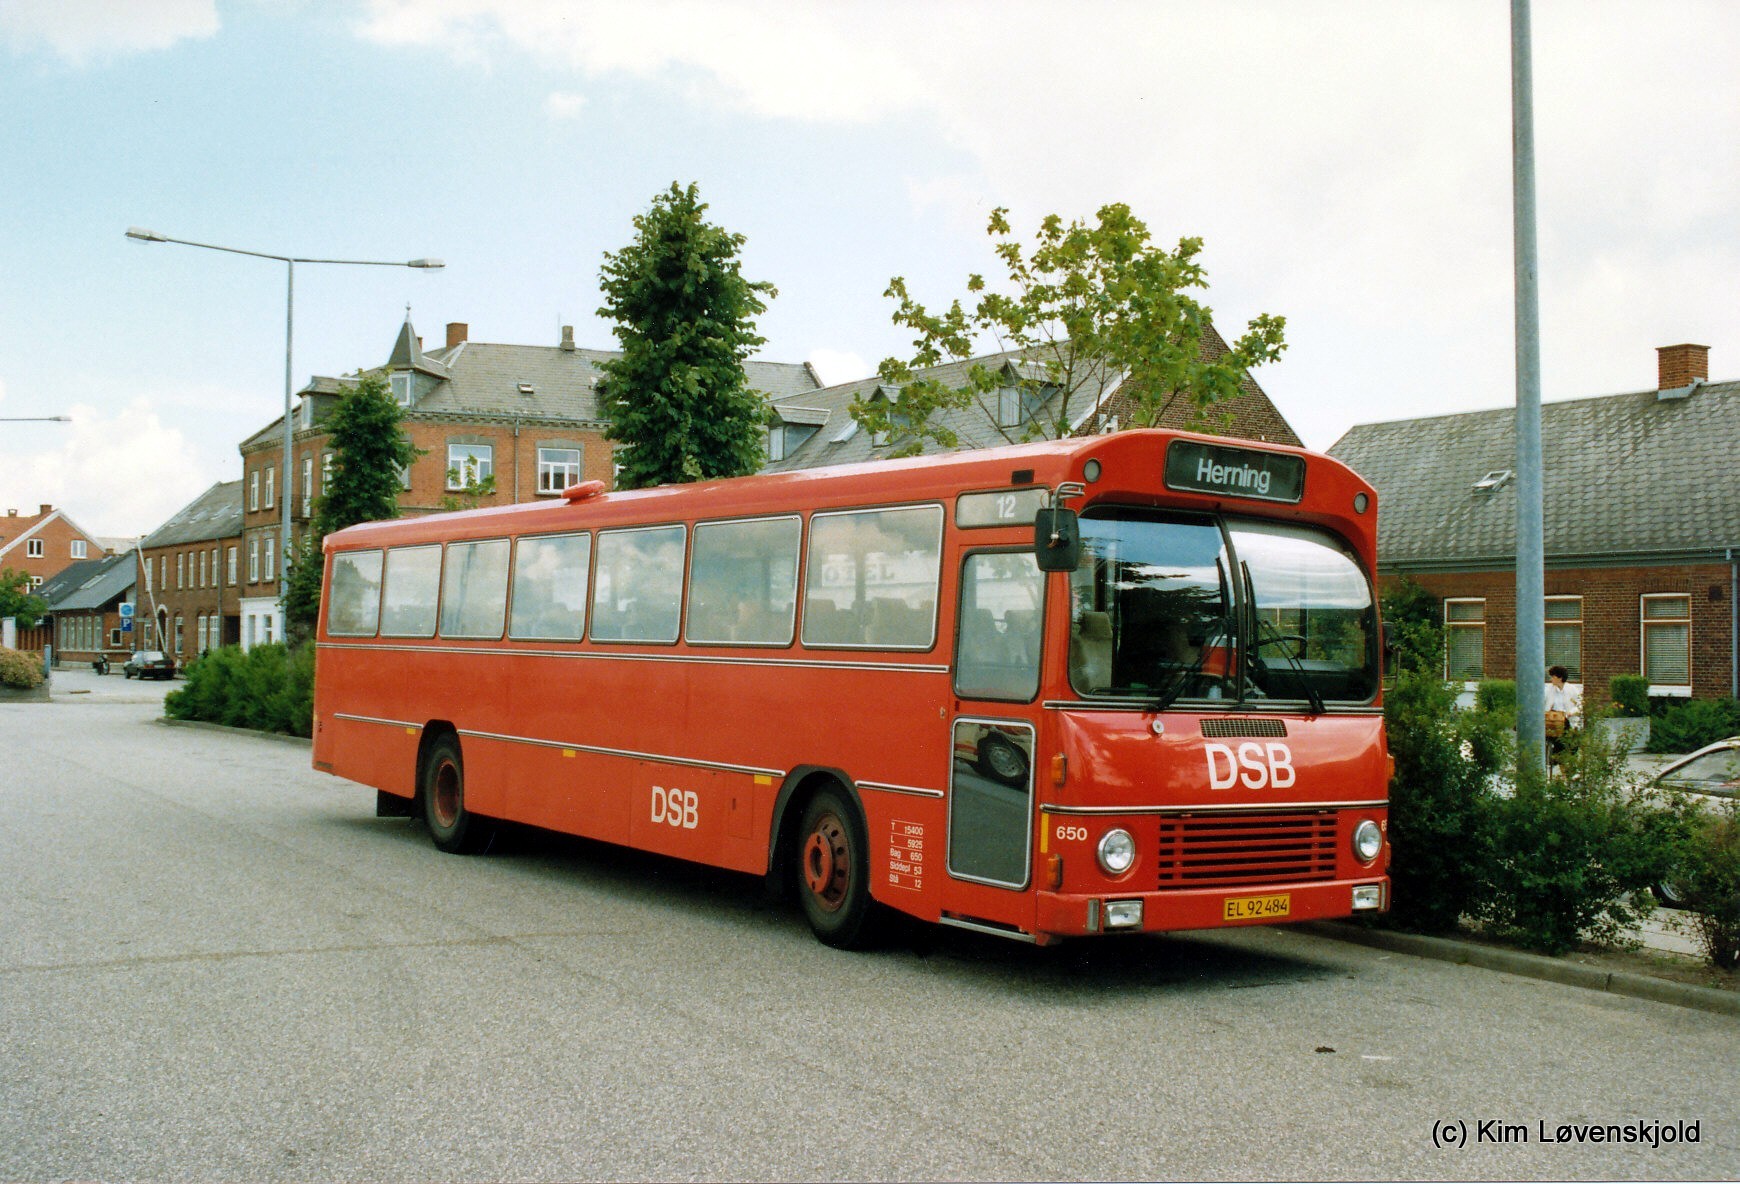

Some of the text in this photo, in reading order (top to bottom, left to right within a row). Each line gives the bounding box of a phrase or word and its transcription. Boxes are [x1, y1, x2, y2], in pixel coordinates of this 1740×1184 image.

[1196, 457, 1271, 494] Herning
[996, 494, 1016, 518] 12
[1204, 742, 1296, 790] DSB
[651, 785, 699, 830] DSB
[891, 822, 924, 836] T 15400
[1056, 825, 1088, 841] 650
[890, 835, 923, 849] L 5925
[889, 847, 923, 862] Bag 650
[914, 879, 922, 888] 12
[1227, 902, 1243, 917] EL
